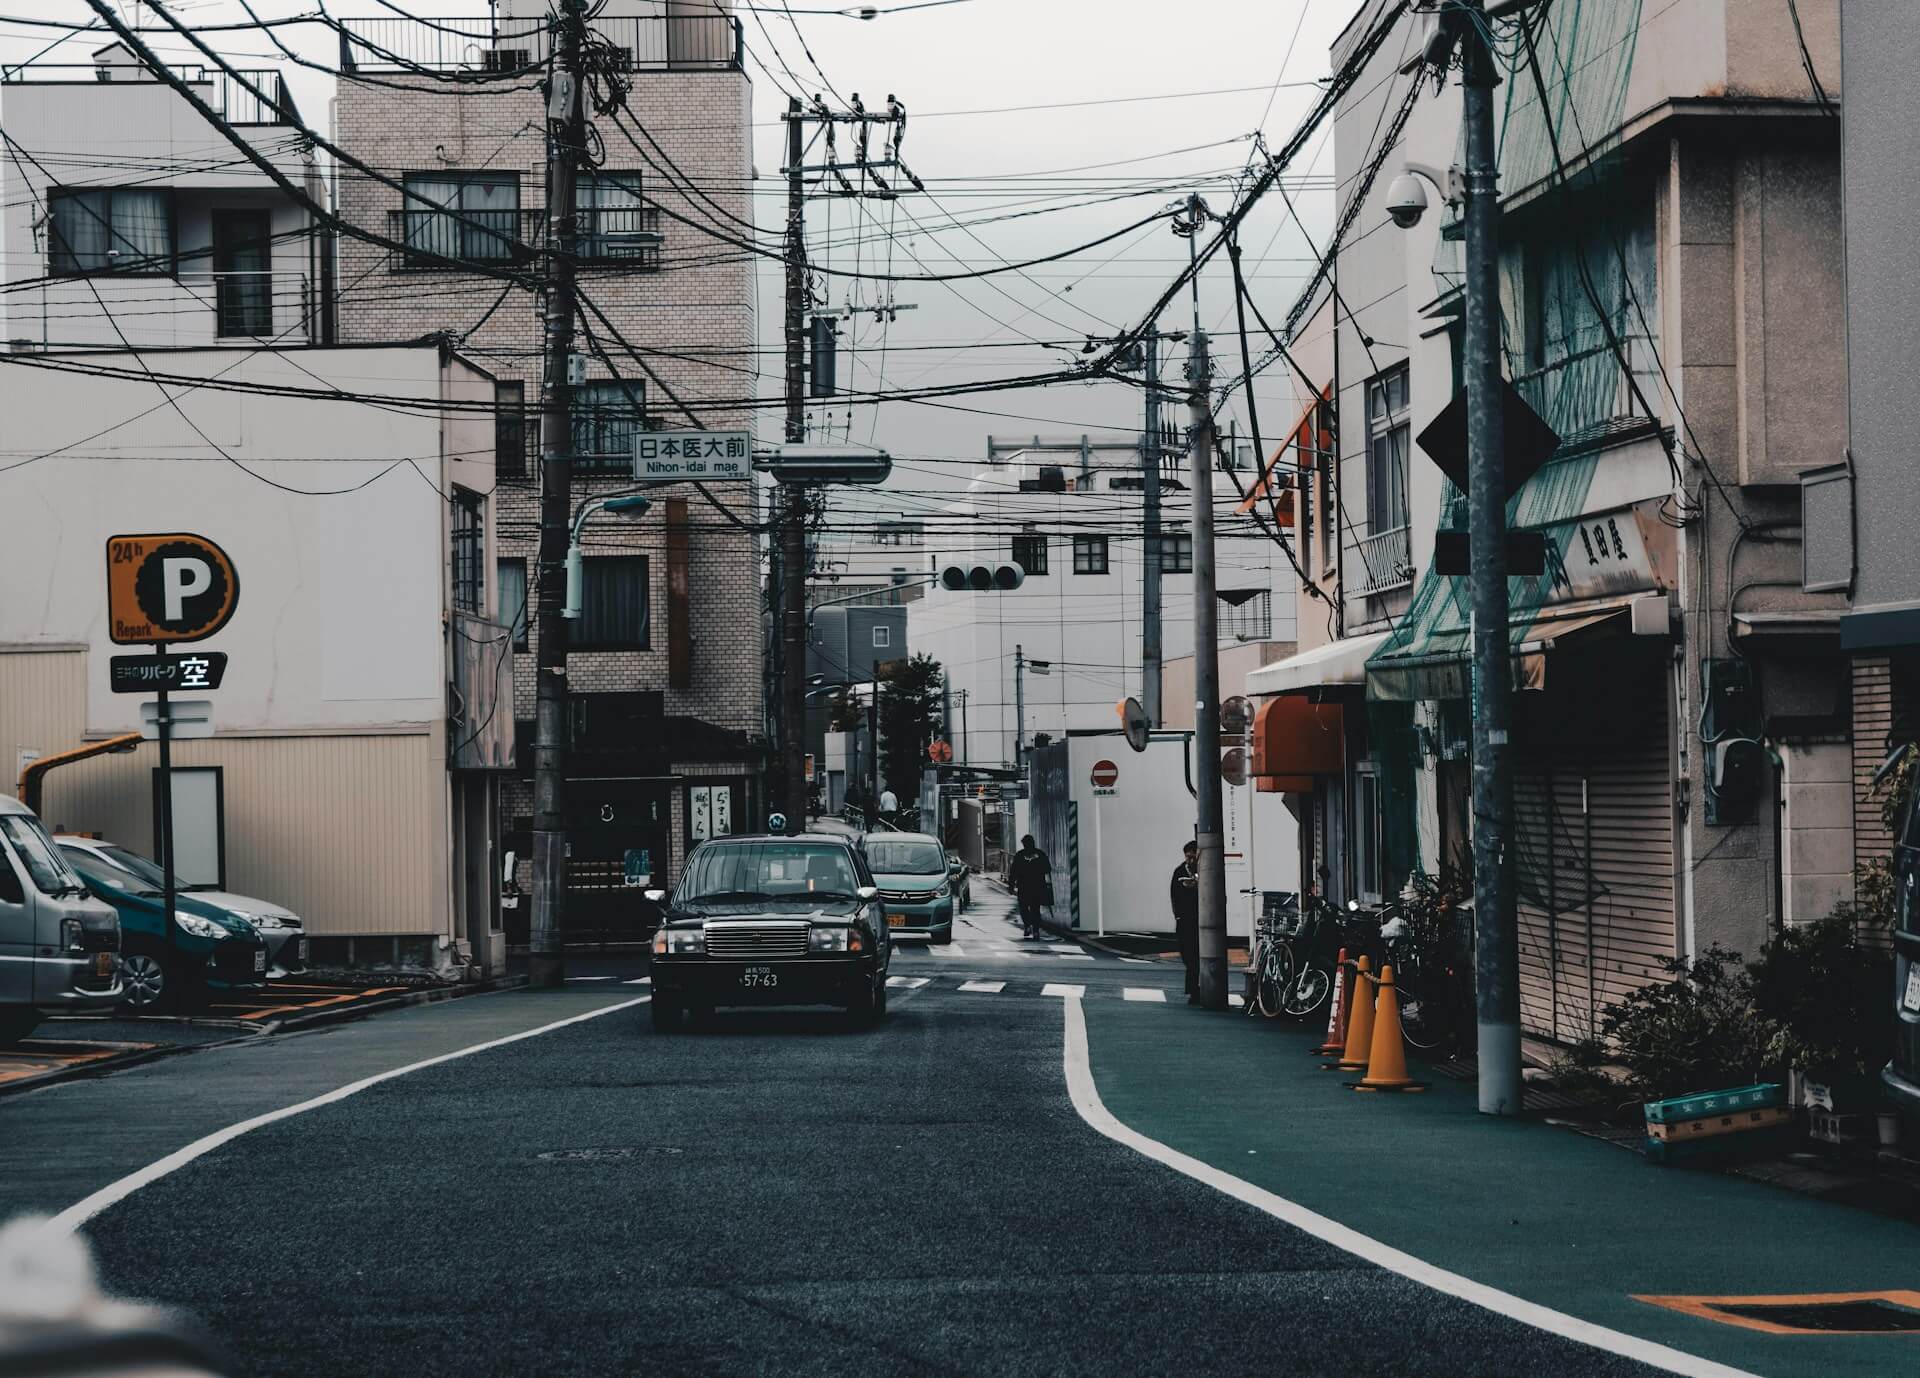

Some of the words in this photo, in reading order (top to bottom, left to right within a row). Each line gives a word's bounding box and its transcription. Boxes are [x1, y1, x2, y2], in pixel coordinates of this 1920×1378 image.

[640, 437, 745, 459] 日本医大前
[647, 461, 706, 473] Nihon-idai
[714, 463, 738, 472] mae
[113, 542, 143, 564] 24h
[163, 556, 212, 622] P
[116, 620, 153, 640] Repark
[116, 665, 177, 680] 三井のリパーク
[179, 656, 210, 687] 空
[744, 974, 778, 987] 57-63
